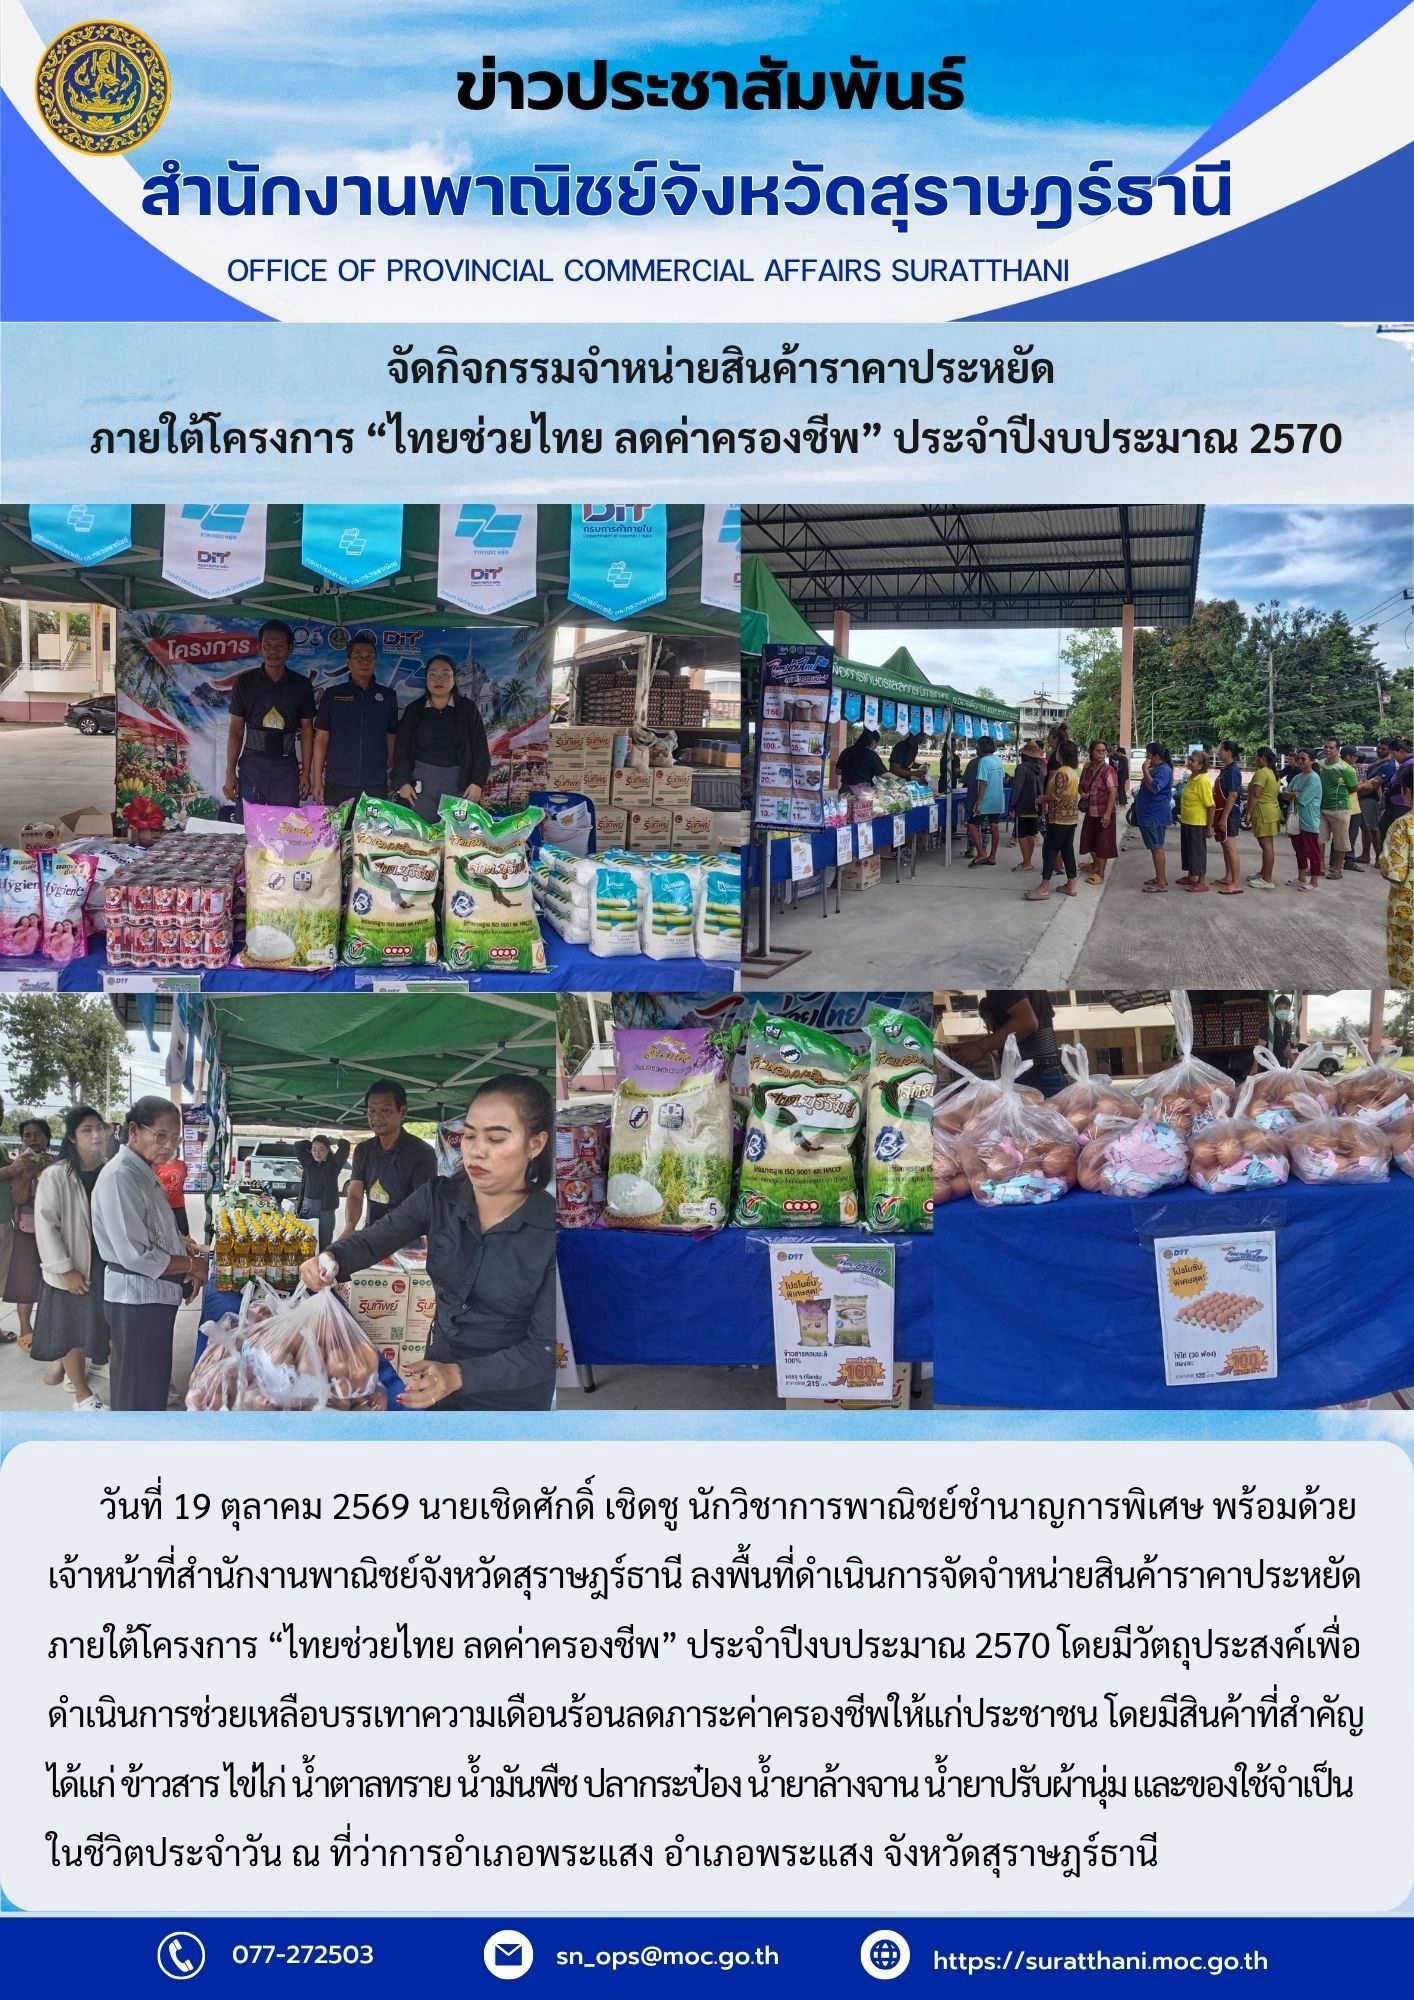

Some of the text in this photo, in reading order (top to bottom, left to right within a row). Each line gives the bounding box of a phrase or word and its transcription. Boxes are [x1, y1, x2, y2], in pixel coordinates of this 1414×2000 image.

[583, 524, 653, 533] กรมการค้าภายใน
[167, 639, 251, 660] โครงการ
[709, 1202, 717, 1216] 5
[358, 1299, 400, 1314] รินทิพย์
